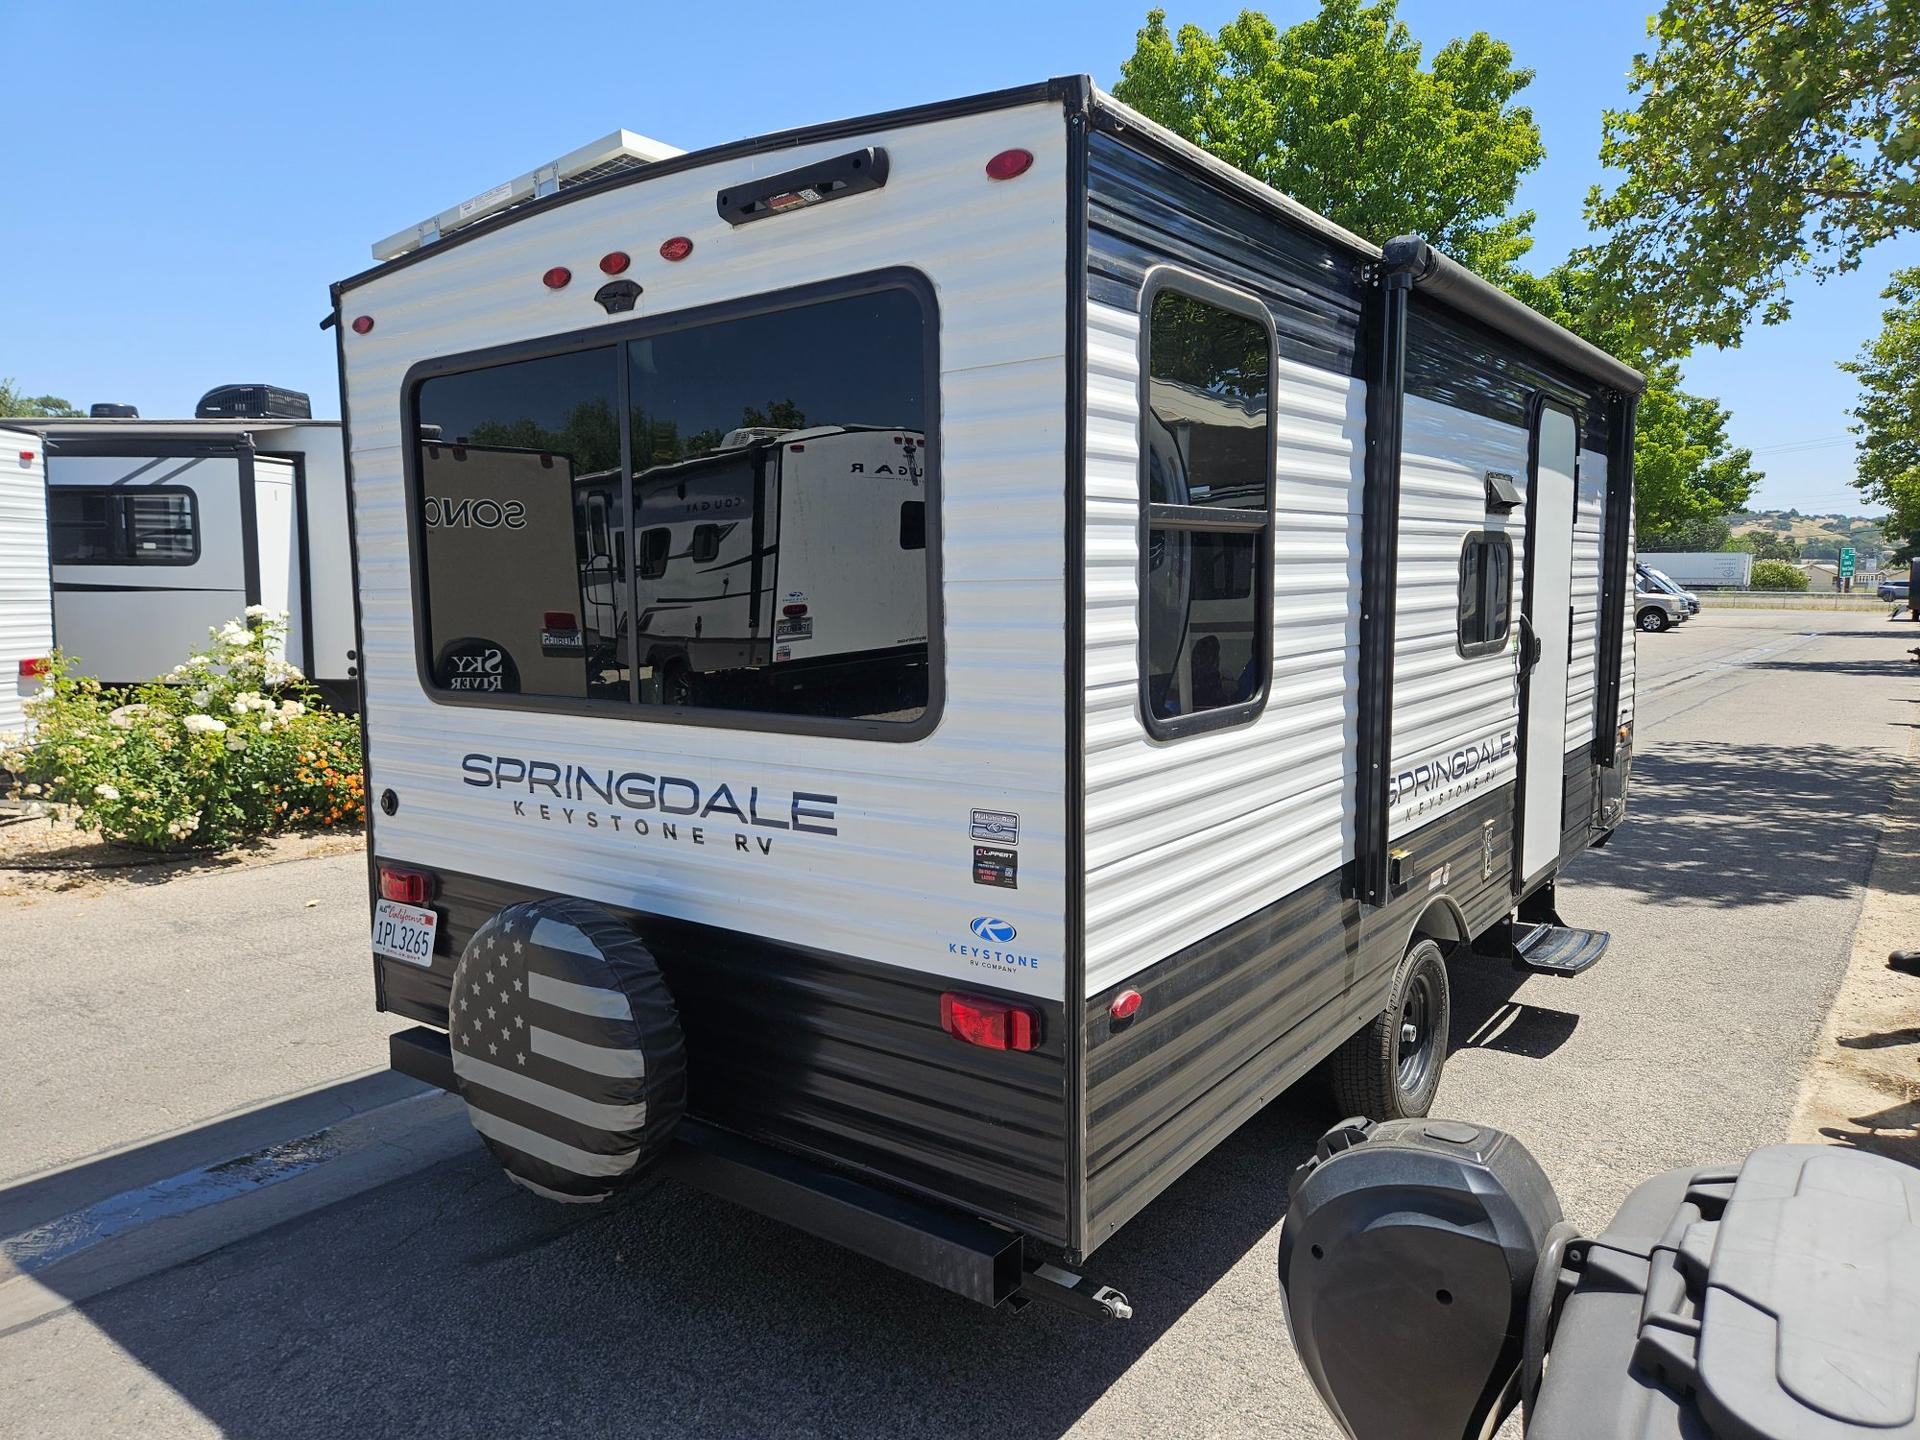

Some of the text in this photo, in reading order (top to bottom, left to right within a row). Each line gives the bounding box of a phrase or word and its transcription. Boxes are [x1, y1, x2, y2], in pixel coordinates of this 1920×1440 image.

[462, 753, 838, 836] SPRINGDALE
[1389, 731, 1511, 808] SPRINGDALE
[1405, 769, 1497, 822] KEYSTONE RV
[513, 800, 773, 856] KEYSTONE RV
[375, 920, 430, 957] 1PL3265
[949, 943, 1038, 968] KEYSTONE
[970, 959, 1017, 973] RV COMPANY
